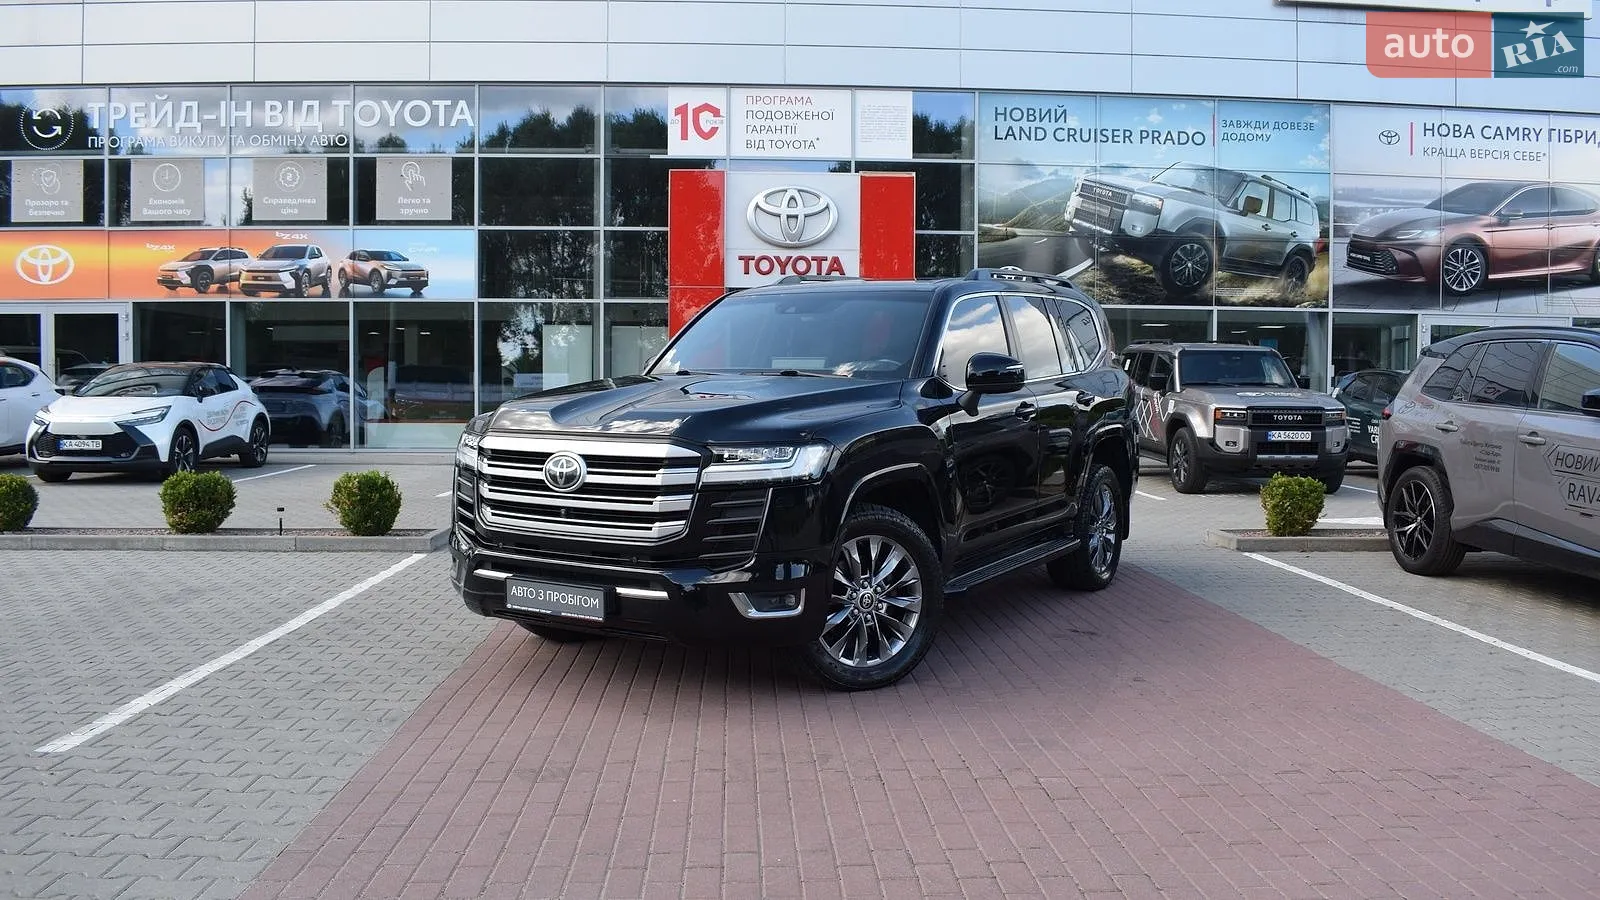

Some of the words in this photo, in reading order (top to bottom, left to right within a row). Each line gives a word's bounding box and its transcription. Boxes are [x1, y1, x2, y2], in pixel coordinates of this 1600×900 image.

[746, 95, 813, 105] ПРОГРАМА
[88, 94, 252, 134] ТРЕЙД-ІН
[264, 100, 323, 133] ВІД
[332, 99, 475, 127] TOYOTA
[746, 108, 835, 121] ПОДОВЖЕНОЇ
[994, 104, 1067, 123] НОВИЙ
[746, 123, 798, 134] ГАРАНТІЇ
[1221, 119, 1270, 130] ЗАВЖДИ
[1273, 121, 1315, 131] ДОВЕЗЕ
[88, 136, 165, 148] ПРОГРАМА
[170, 135, 226, 148] ВИКУПУ
[230, 135, 245, 147] ТА
[250, 134, 306, 147] ОБМІНУ
[310, 134, 348, 146] АВТО
[994, 125, 1047, 141] LAND
[1053, 127, 1133, 144] CRUISER
[1139, 130, 1206, 146] PRADO
[1221, 132, 1271, 143] ДОДОМУ
[1423, 122, 1475, 139] НОВА
[1481, 125, 1543, 142] CAMRY
[1548, 128, 1600, 148] ГІБРИ
[746, 139, 766, 151] ВІД
[1423, 147, 1467, 159] КРАЩА
[1470, 148, 1510, 160] ВЕРСІЯ
[25, 199, 59, 207] Прозоро
[738, 255, 846, 276] TOYOTA
[510, 585, 536, 599] АВТО
[546, 590, 600, 609] ПРОБІГОМ
